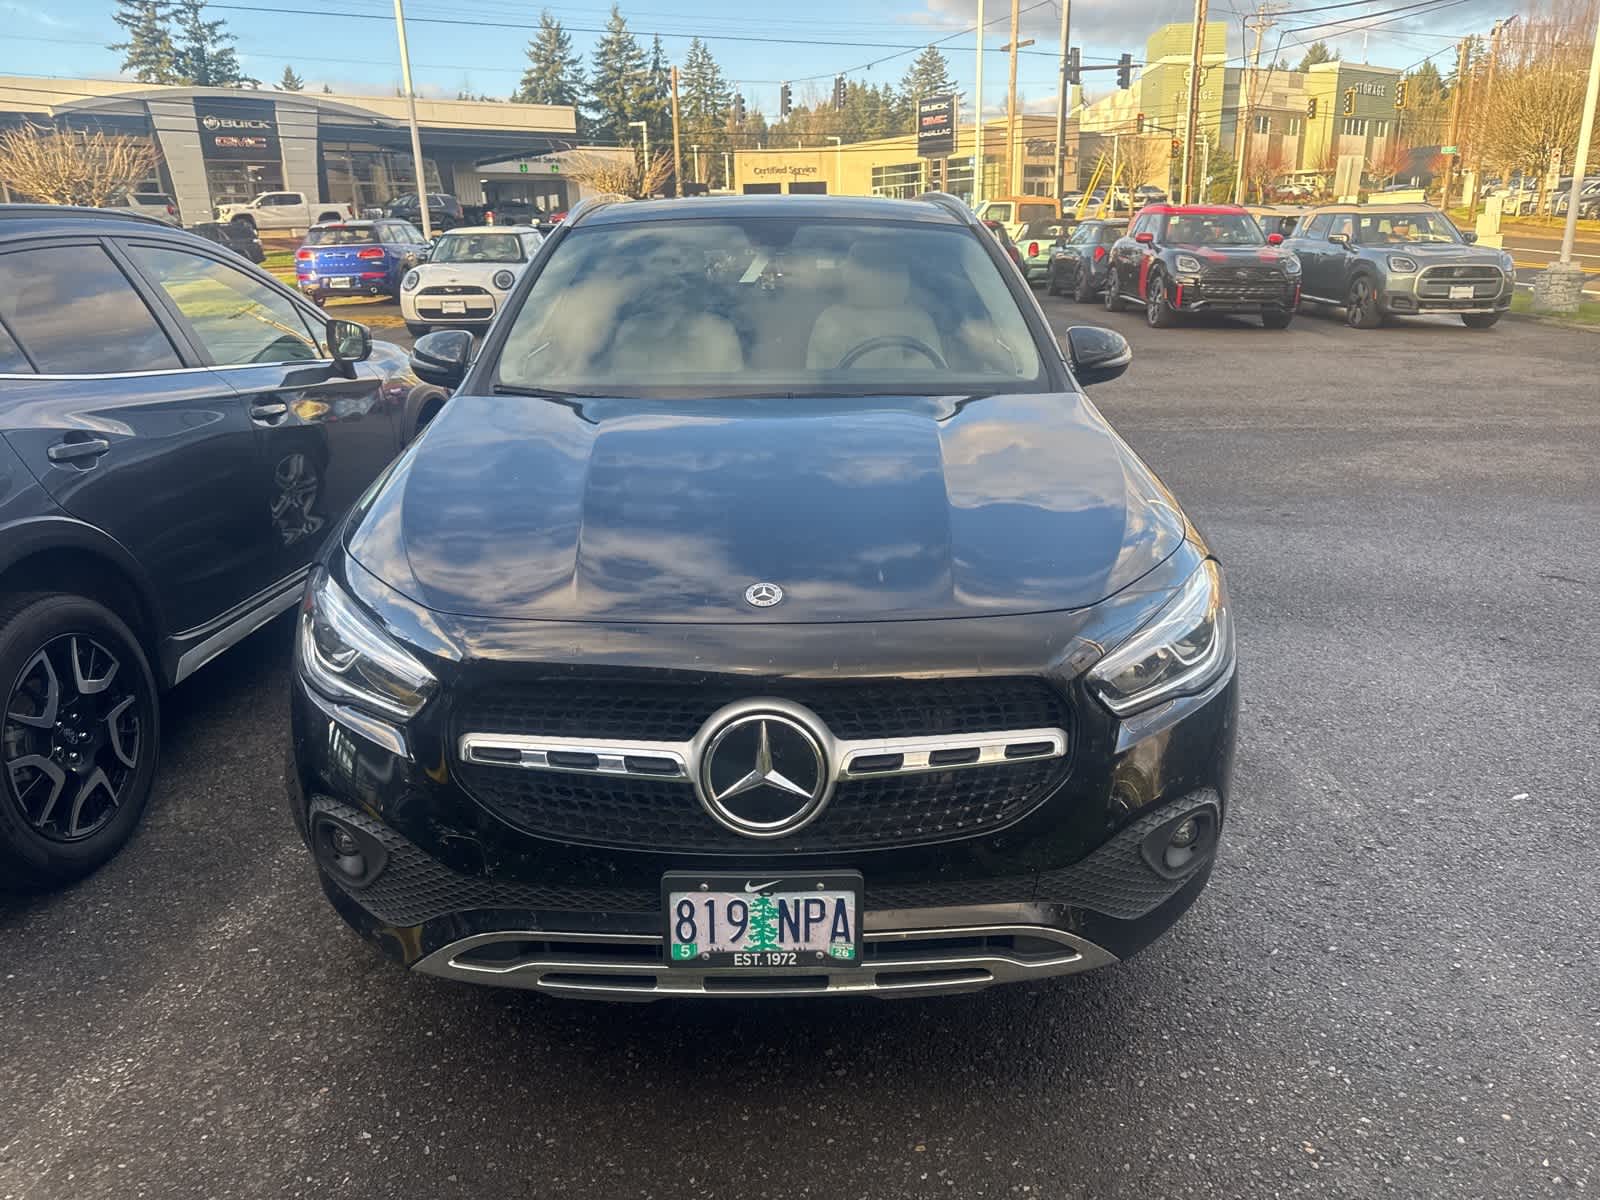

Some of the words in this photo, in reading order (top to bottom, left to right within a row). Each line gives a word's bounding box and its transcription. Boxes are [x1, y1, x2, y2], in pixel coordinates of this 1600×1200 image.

[1355, 82, 1385, 96] STORAGE
[920, 102, 949, 112] BUICK
[220, 119, 272, 129] BUICK
[921, 114, 948, 126] GMC
[215, 136, 267, 148] GMC
[753, 166, 787, 176] Certified
[788, 166, 817, 176] Service
[675, 899, 750, 945] 819
[777, 898, 852, 944] NPA
[680, 944, 691, 958] 5
[834, 947, 849, 958] 26
[733, 953, 763, 966] EST.
[766, 952, 798, 965] 1972
